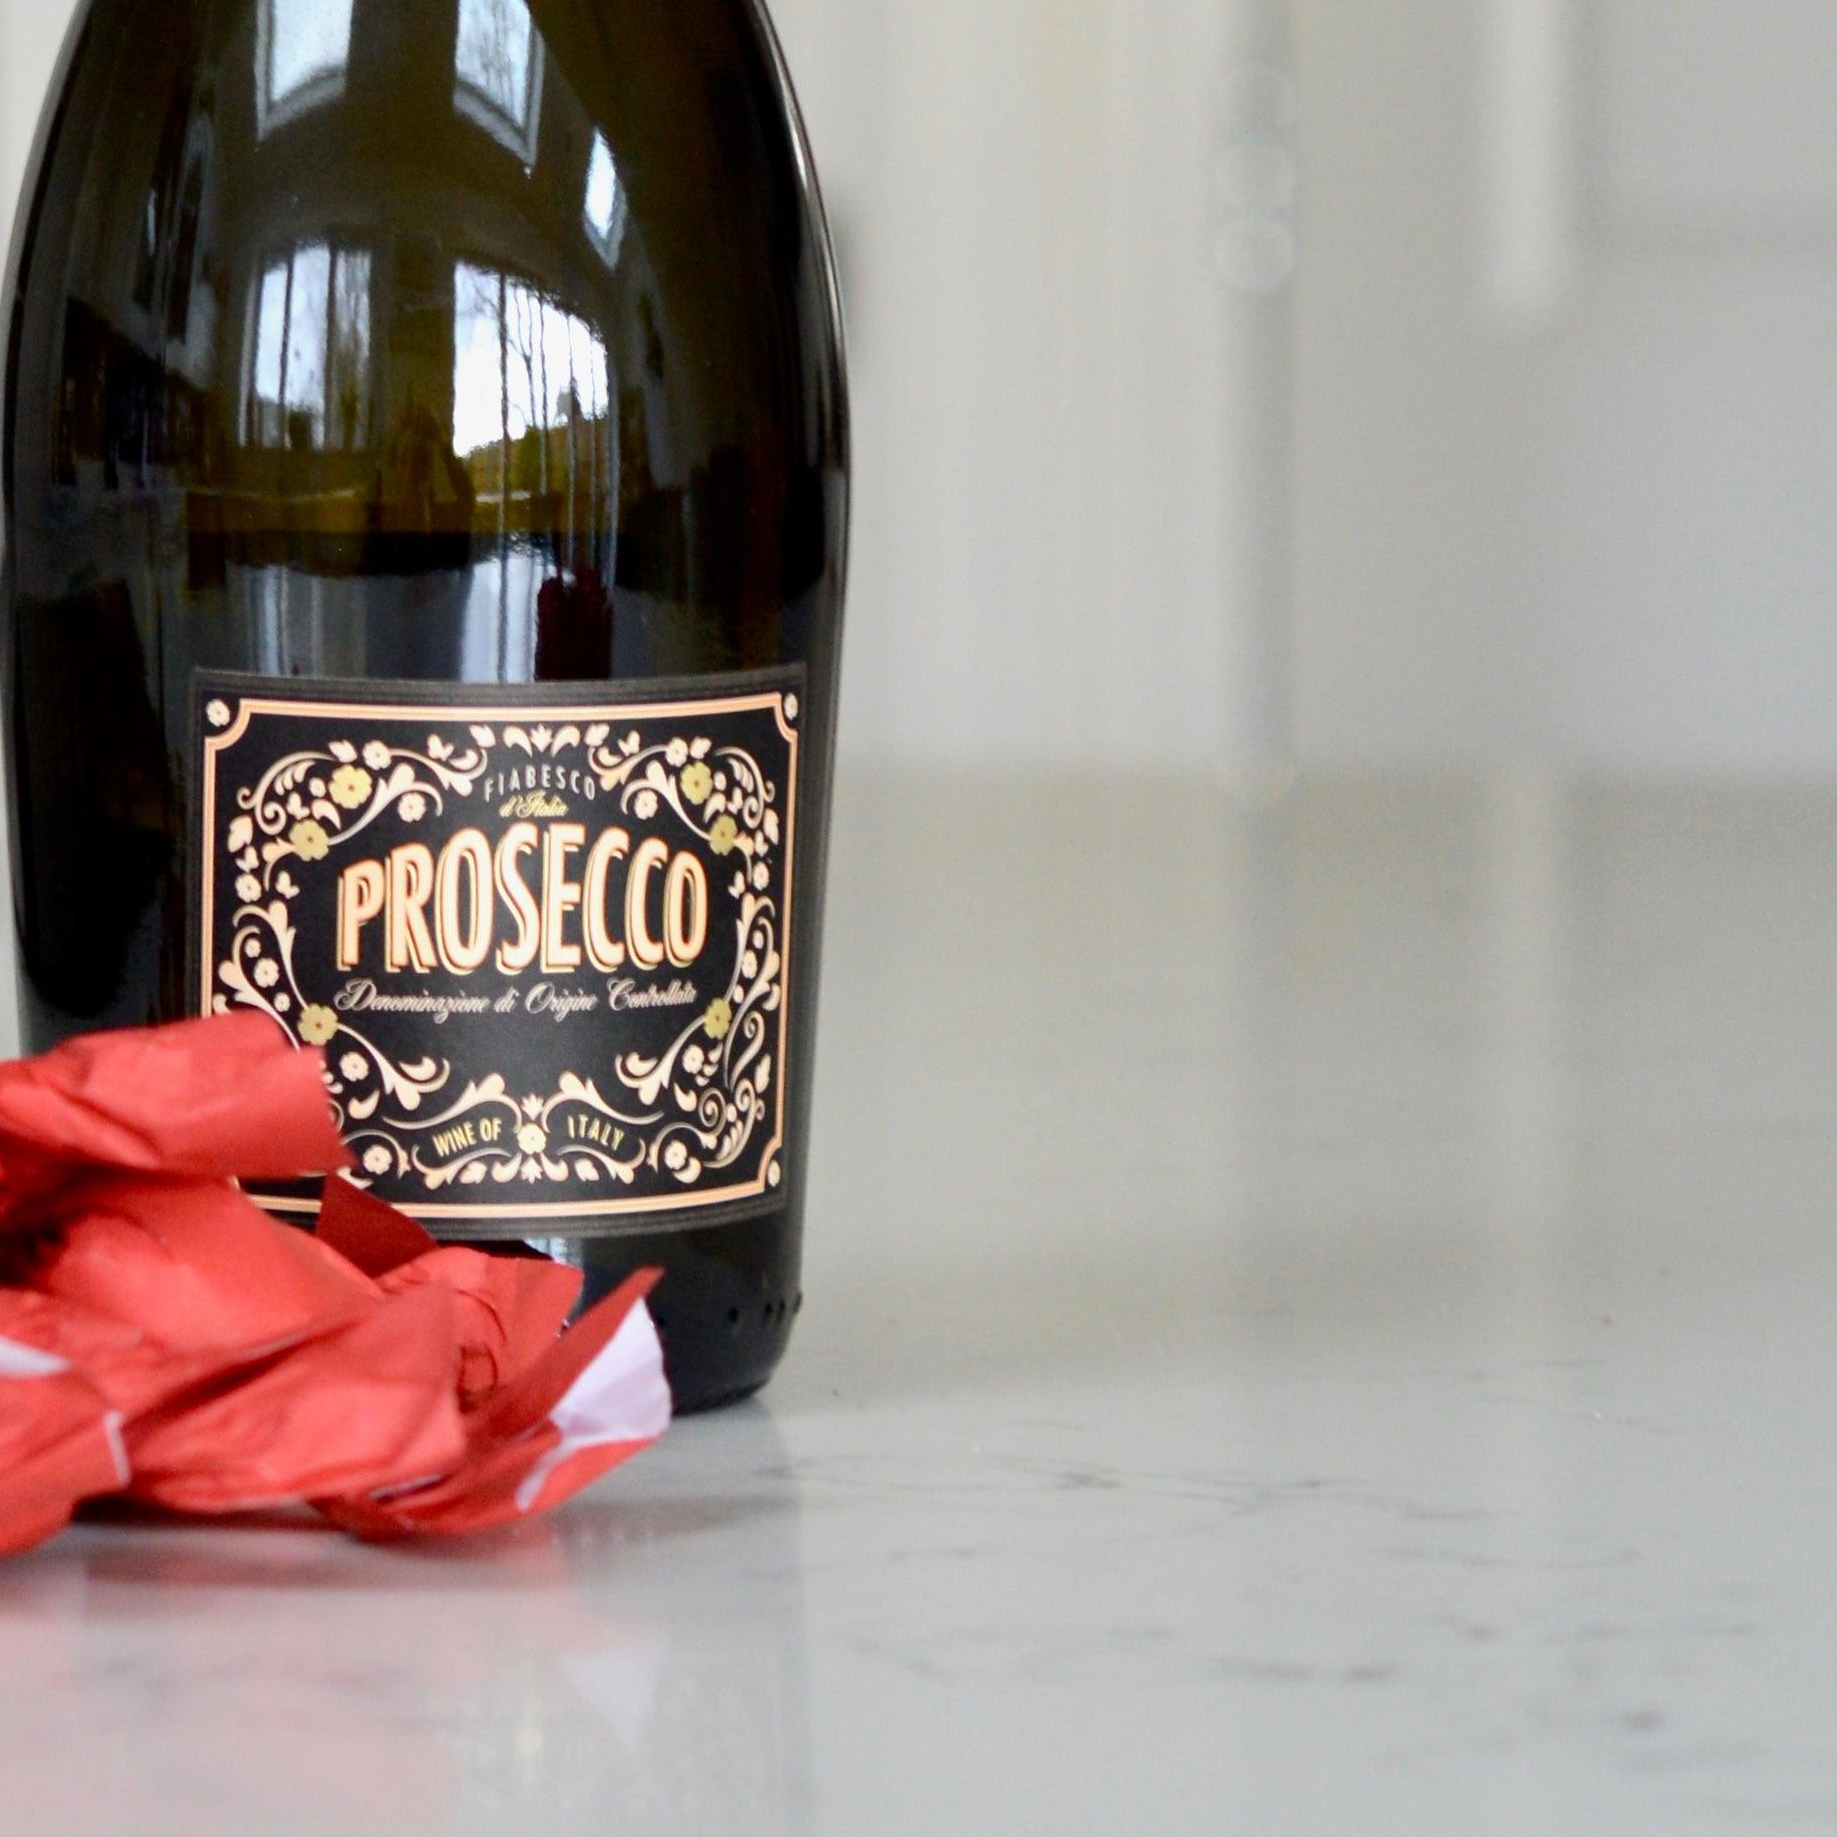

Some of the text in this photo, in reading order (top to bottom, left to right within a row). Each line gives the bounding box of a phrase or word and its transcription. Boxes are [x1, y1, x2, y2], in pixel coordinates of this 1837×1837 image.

[483, 763, 595, 802] FIABESCO
[336, 821, 709, 976] PROSECCO
[333, 977, 698, 1024] Denominazione di Origine Controllata
[432, 1113, 625, 1158] WINE OF ITALY
